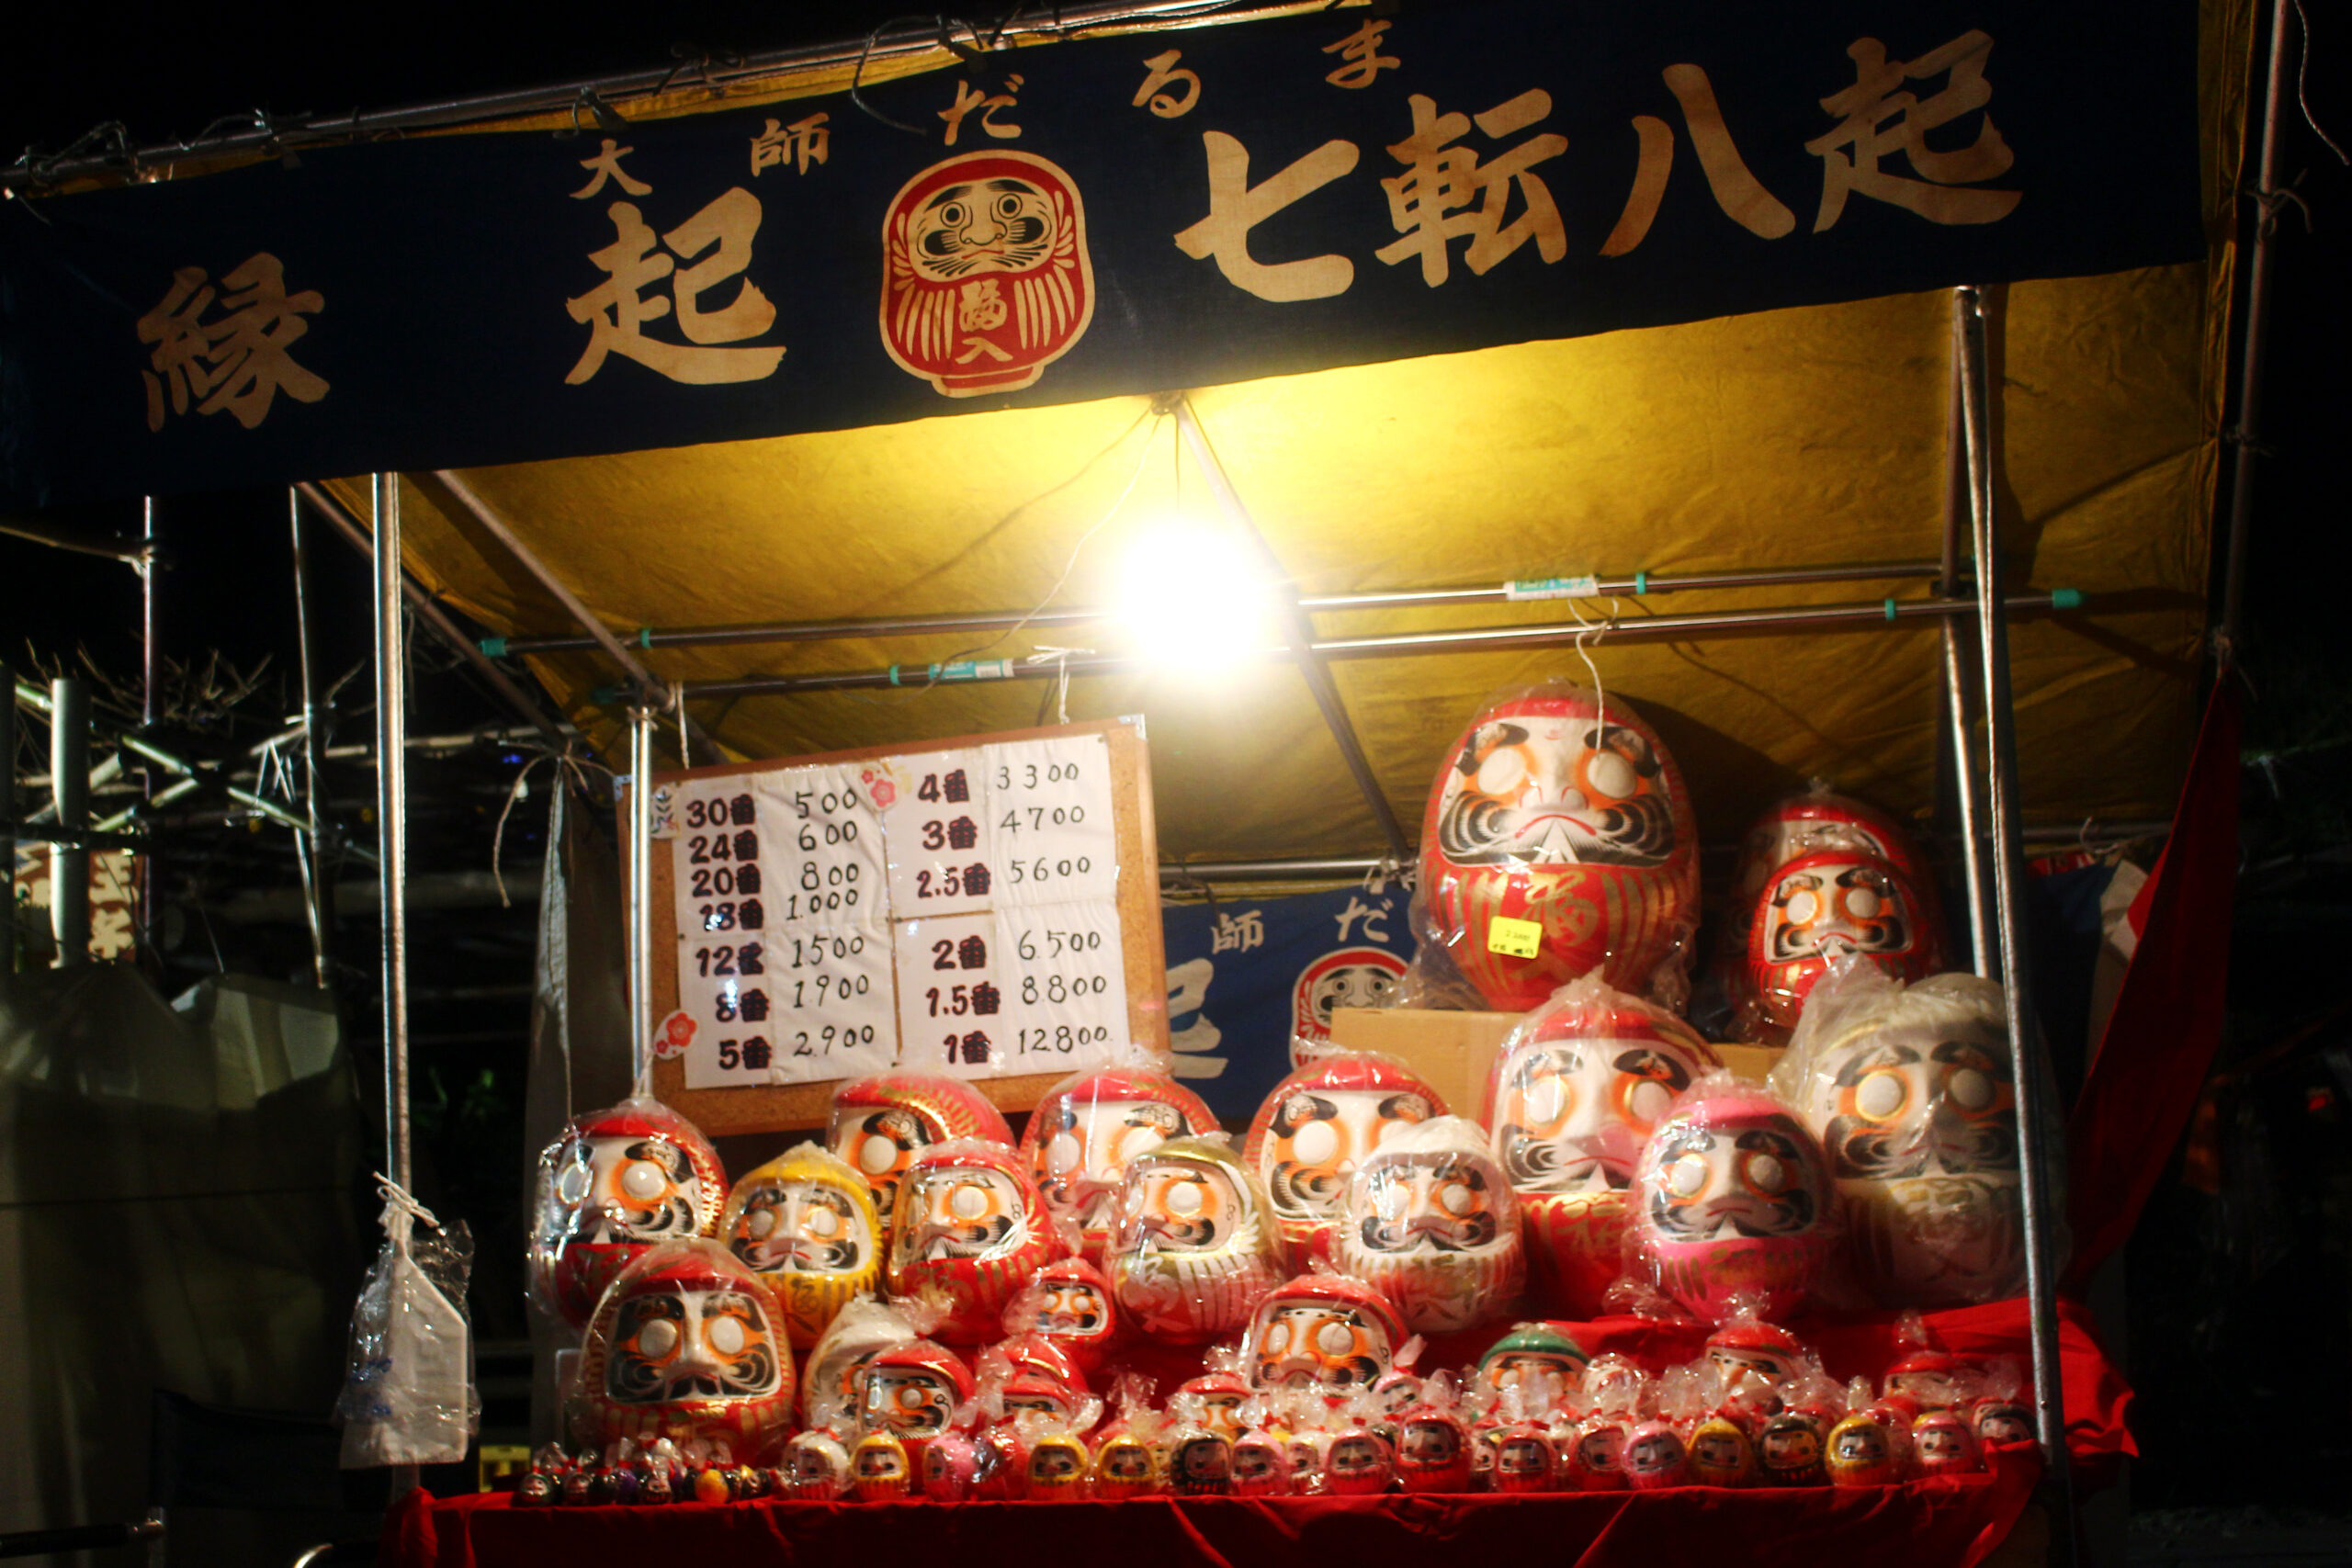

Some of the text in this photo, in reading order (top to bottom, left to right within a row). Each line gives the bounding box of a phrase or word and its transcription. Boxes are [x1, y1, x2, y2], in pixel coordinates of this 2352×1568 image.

[570, 19, 1401, 199] 大師だるま
[1174, 28, 2021, 301] 七転八起
[686, 788, 857, 828] 30番 500
[689, 820, 857, 864] 24番 600
[922, 806, 1084, 850] 3番 4700
[691, 862, 858, 897] 20番 800
[1011, 857, 1091, 883] 5600
[932, 935, 986, 970] 2番
[926, 981, 1000, 1017] 1.5番
[718, 1035, 772, 1070] 5番
